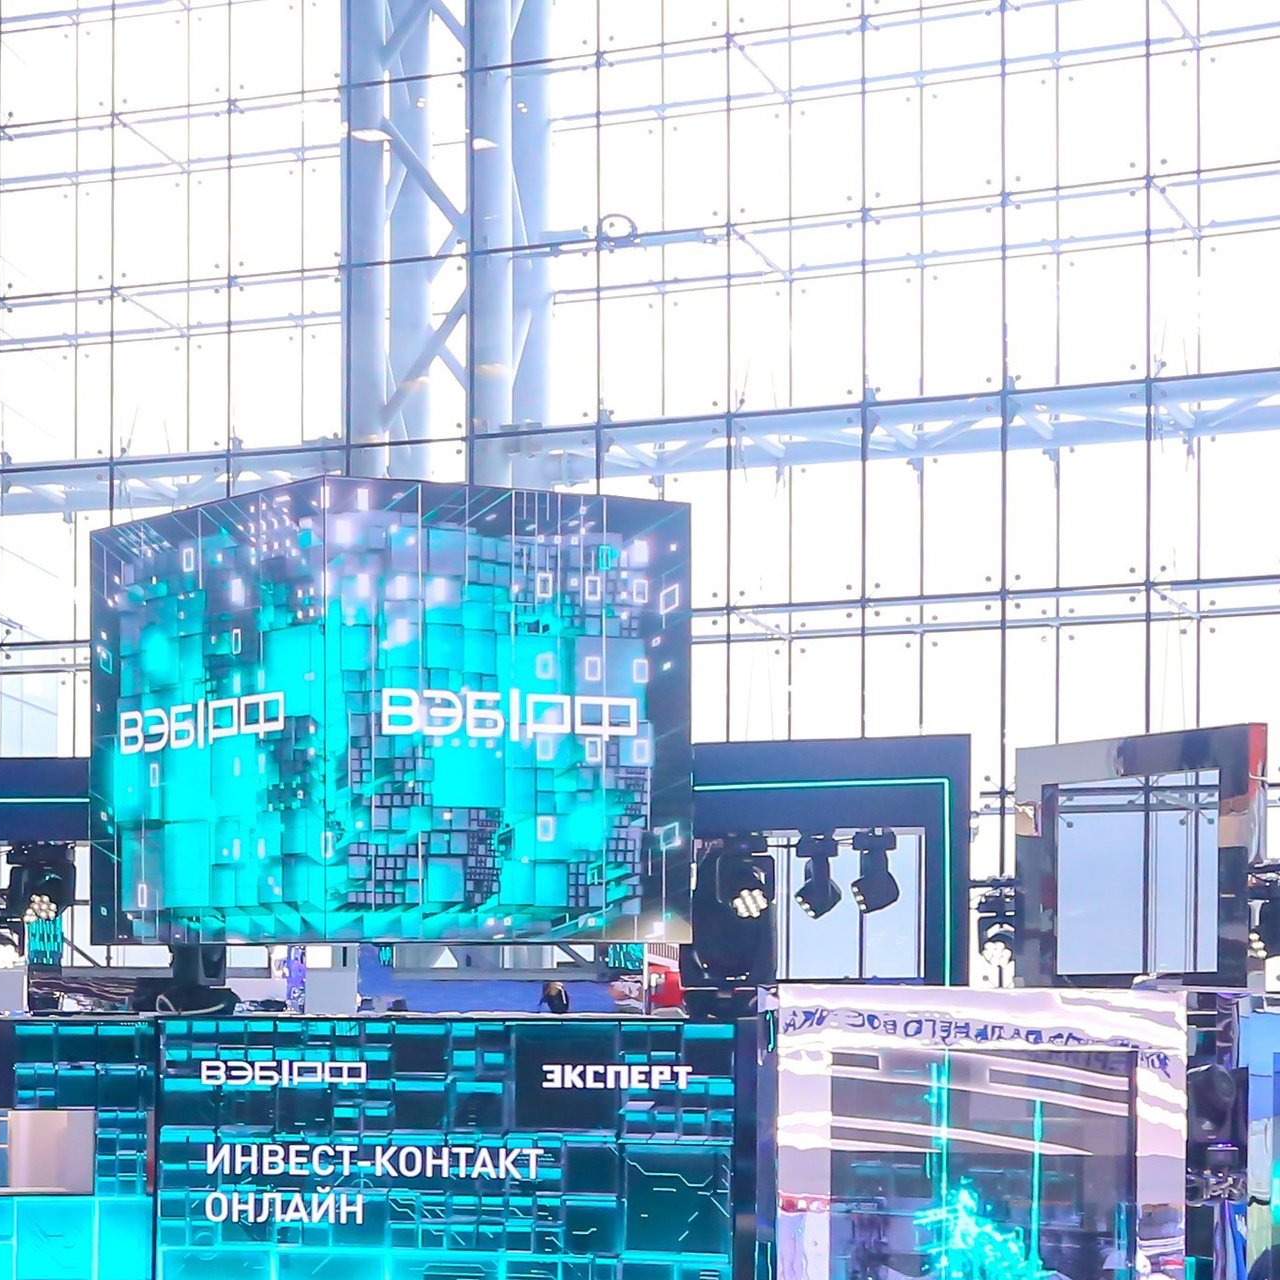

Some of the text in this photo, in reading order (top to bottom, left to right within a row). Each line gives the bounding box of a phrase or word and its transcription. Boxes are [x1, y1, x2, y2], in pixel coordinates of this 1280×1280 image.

[541, 1063, 694, 1090] ЭКСПЕРТ
[205, 1143, 545, 1180] ИНВЕСТ-КОНТАКТ
[204, 1185, 365, 1225] ОНЛАЙН
